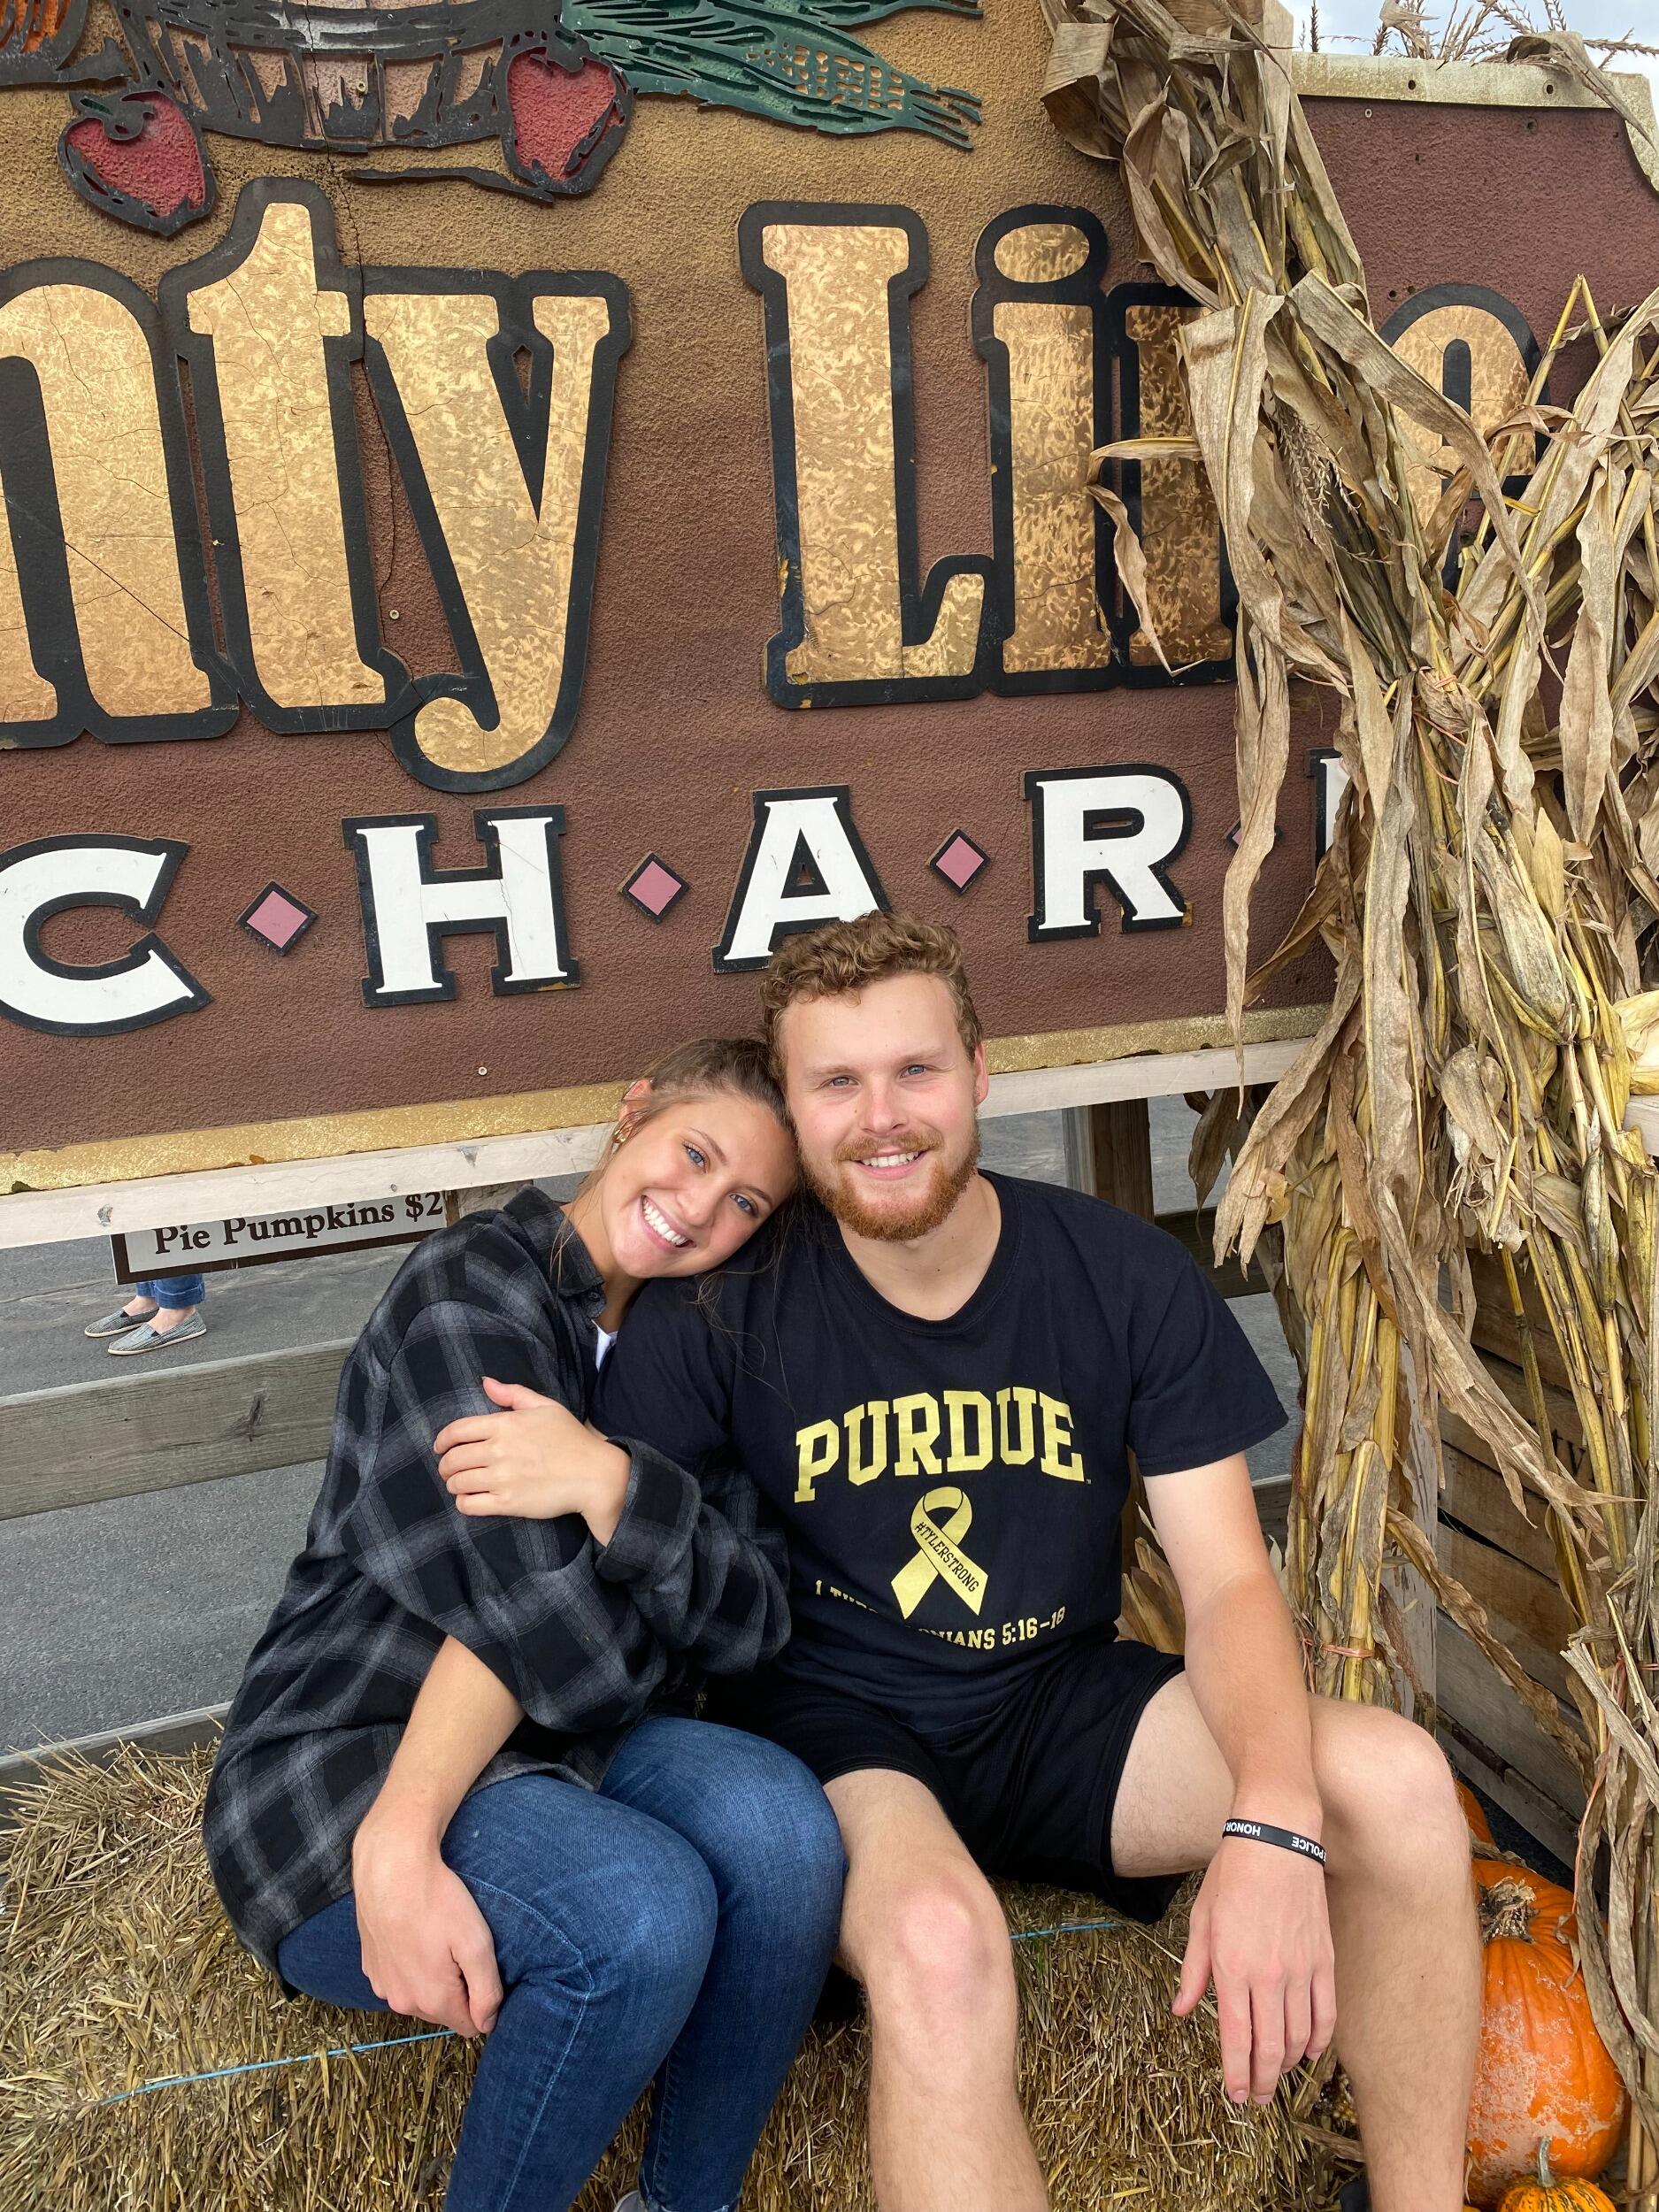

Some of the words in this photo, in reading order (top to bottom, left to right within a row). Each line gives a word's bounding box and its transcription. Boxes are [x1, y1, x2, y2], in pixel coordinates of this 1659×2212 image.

[151, 1225, 211, 1255] Pie
[219, 1202, 396, 1246] Pumpkins
[794, 1386, 1085, 1503] PURDUE
[914, 1521, 979, 1594] #TYLERSTRONG
[1002, 1606, 1066, 1646] 5:16-18
[1291, 1836, 1325, 1860] POLICE
